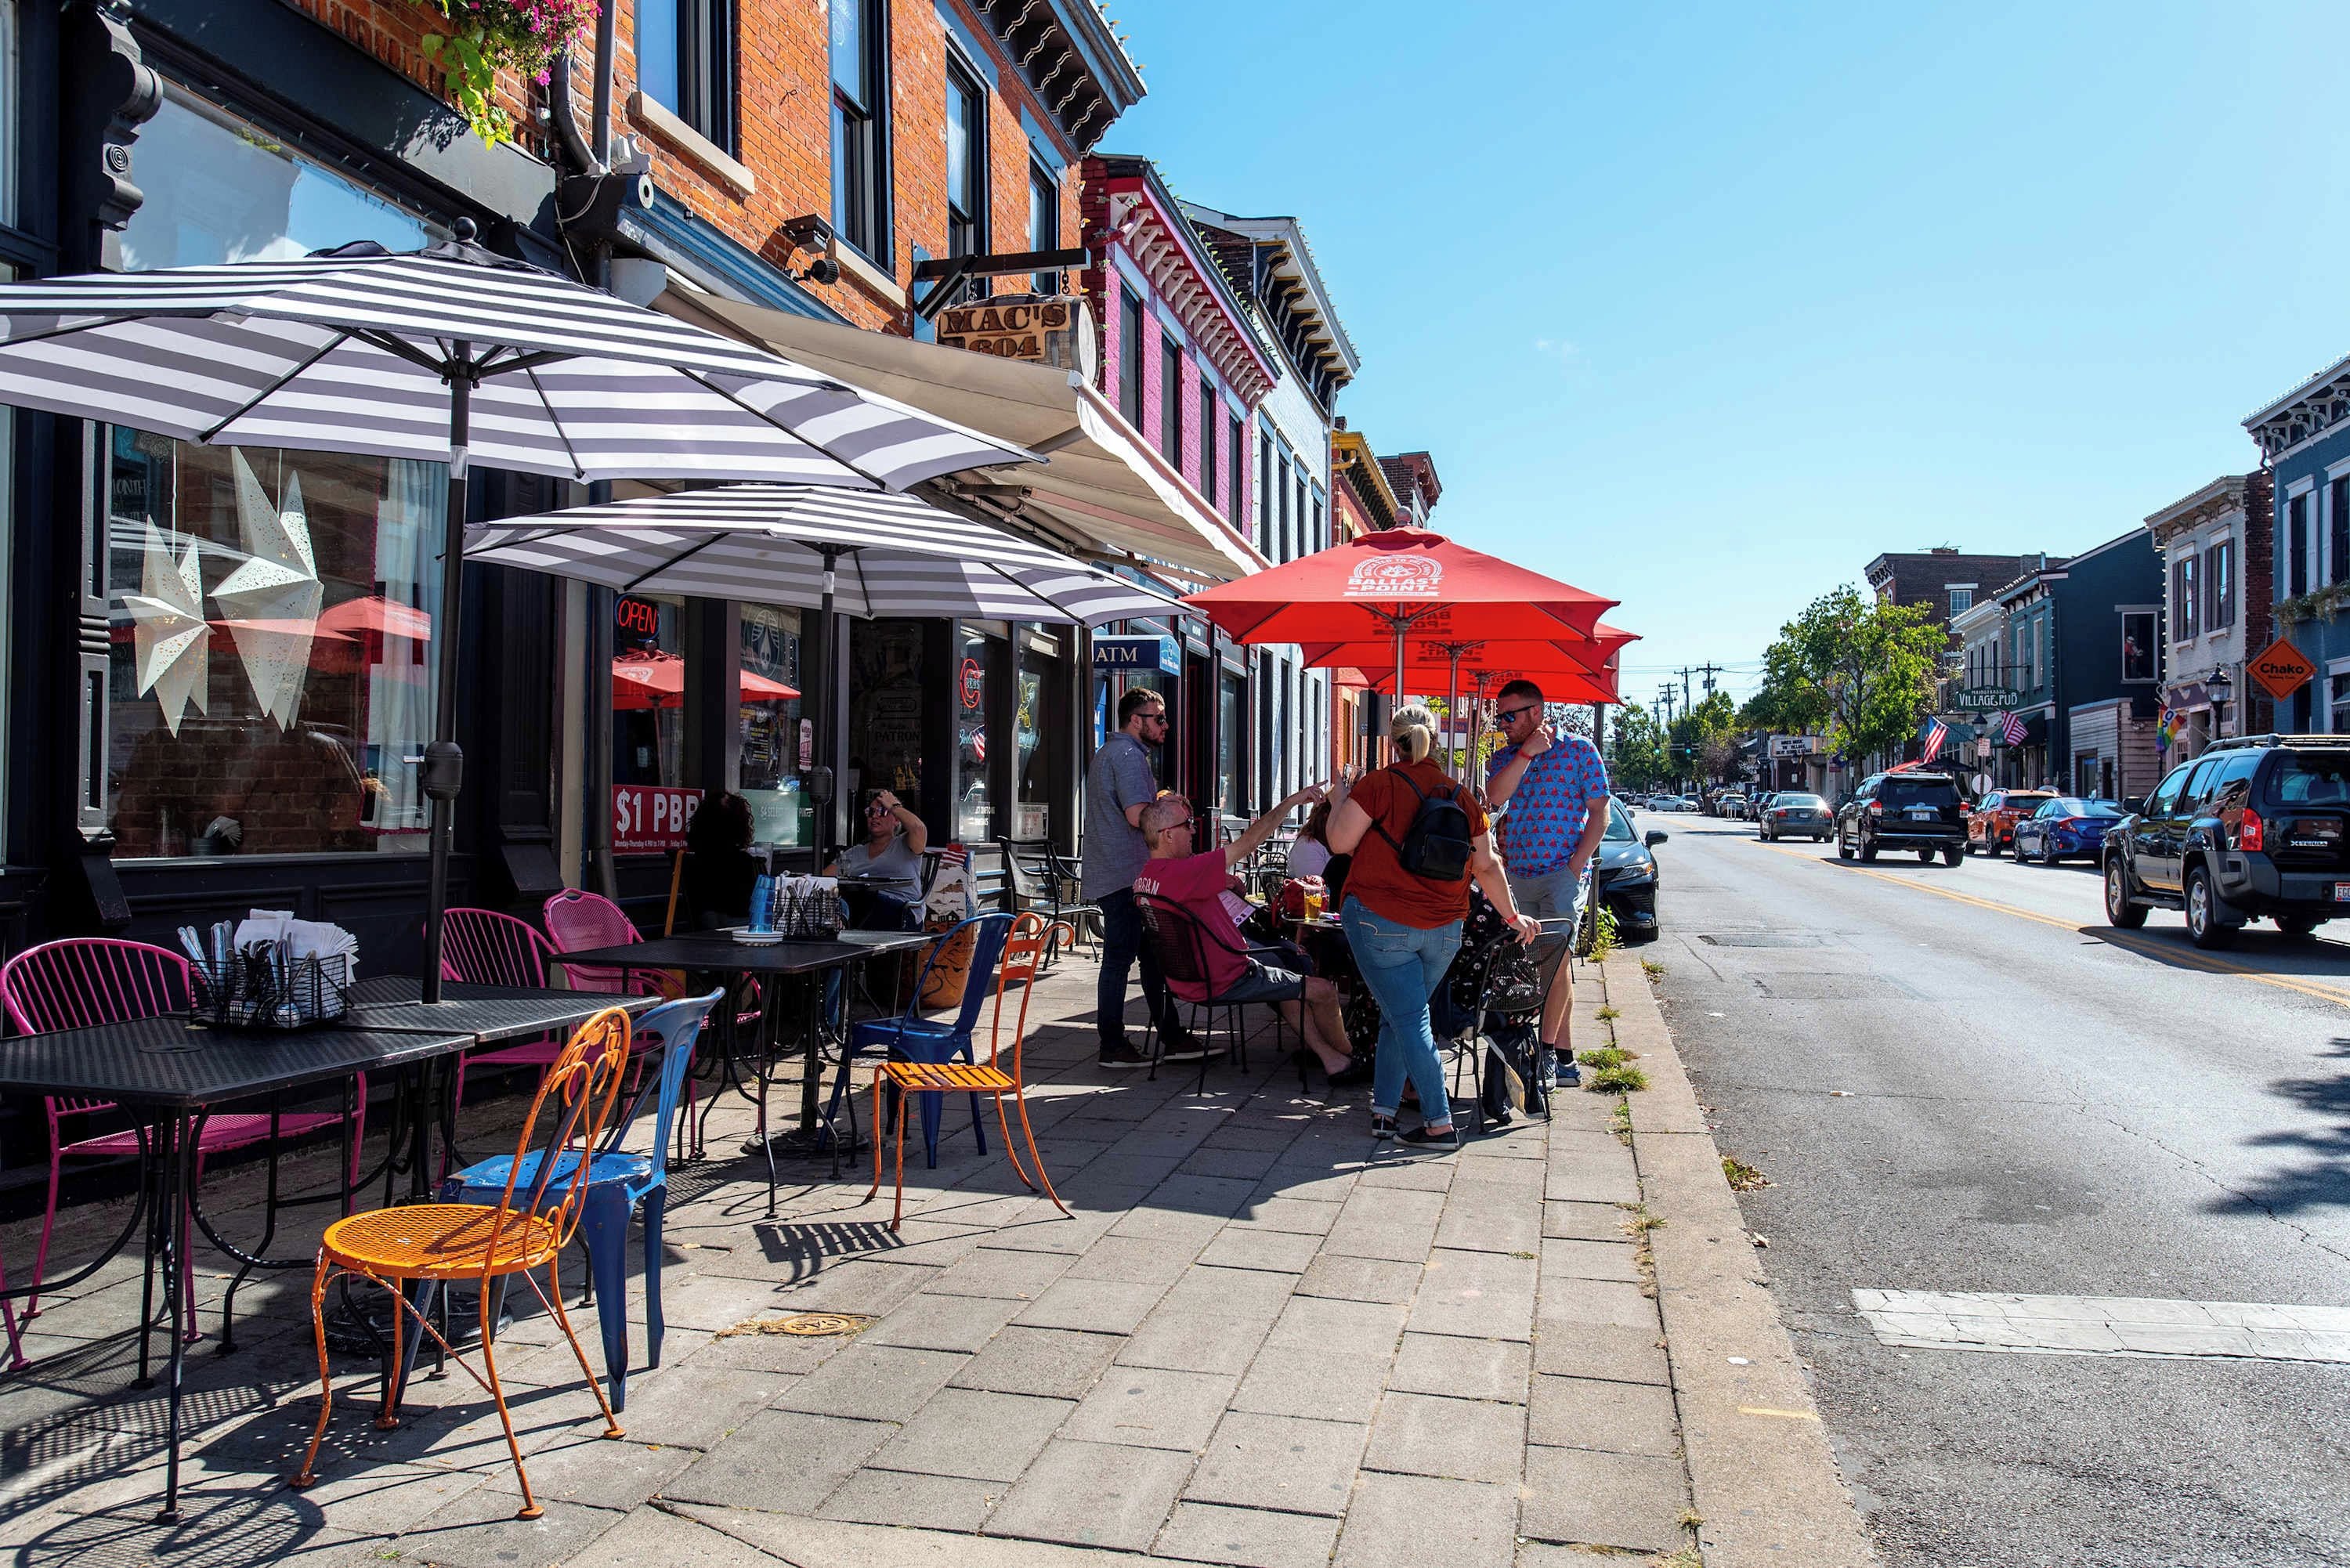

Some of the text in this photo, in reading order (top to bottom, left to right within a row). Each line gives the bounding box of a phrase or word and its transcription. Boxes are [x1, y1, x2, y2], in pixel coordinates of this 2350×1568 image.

[943, 303, 1067, 334] MAC'S
[969, 335, 1042, 358] 604
[1347, 576, 1444, 585] BALLAST
[617, 600, 658, 634] OPEN
[1095, 647, 1138, 663] ATM
[2260, 663, 2305, 674] Chako
[1959, 692, 2018, 706] VILLAGE PUB
[616, 788, 642, 839] $1
[1133, 877, 1160, 896] ORGAN
